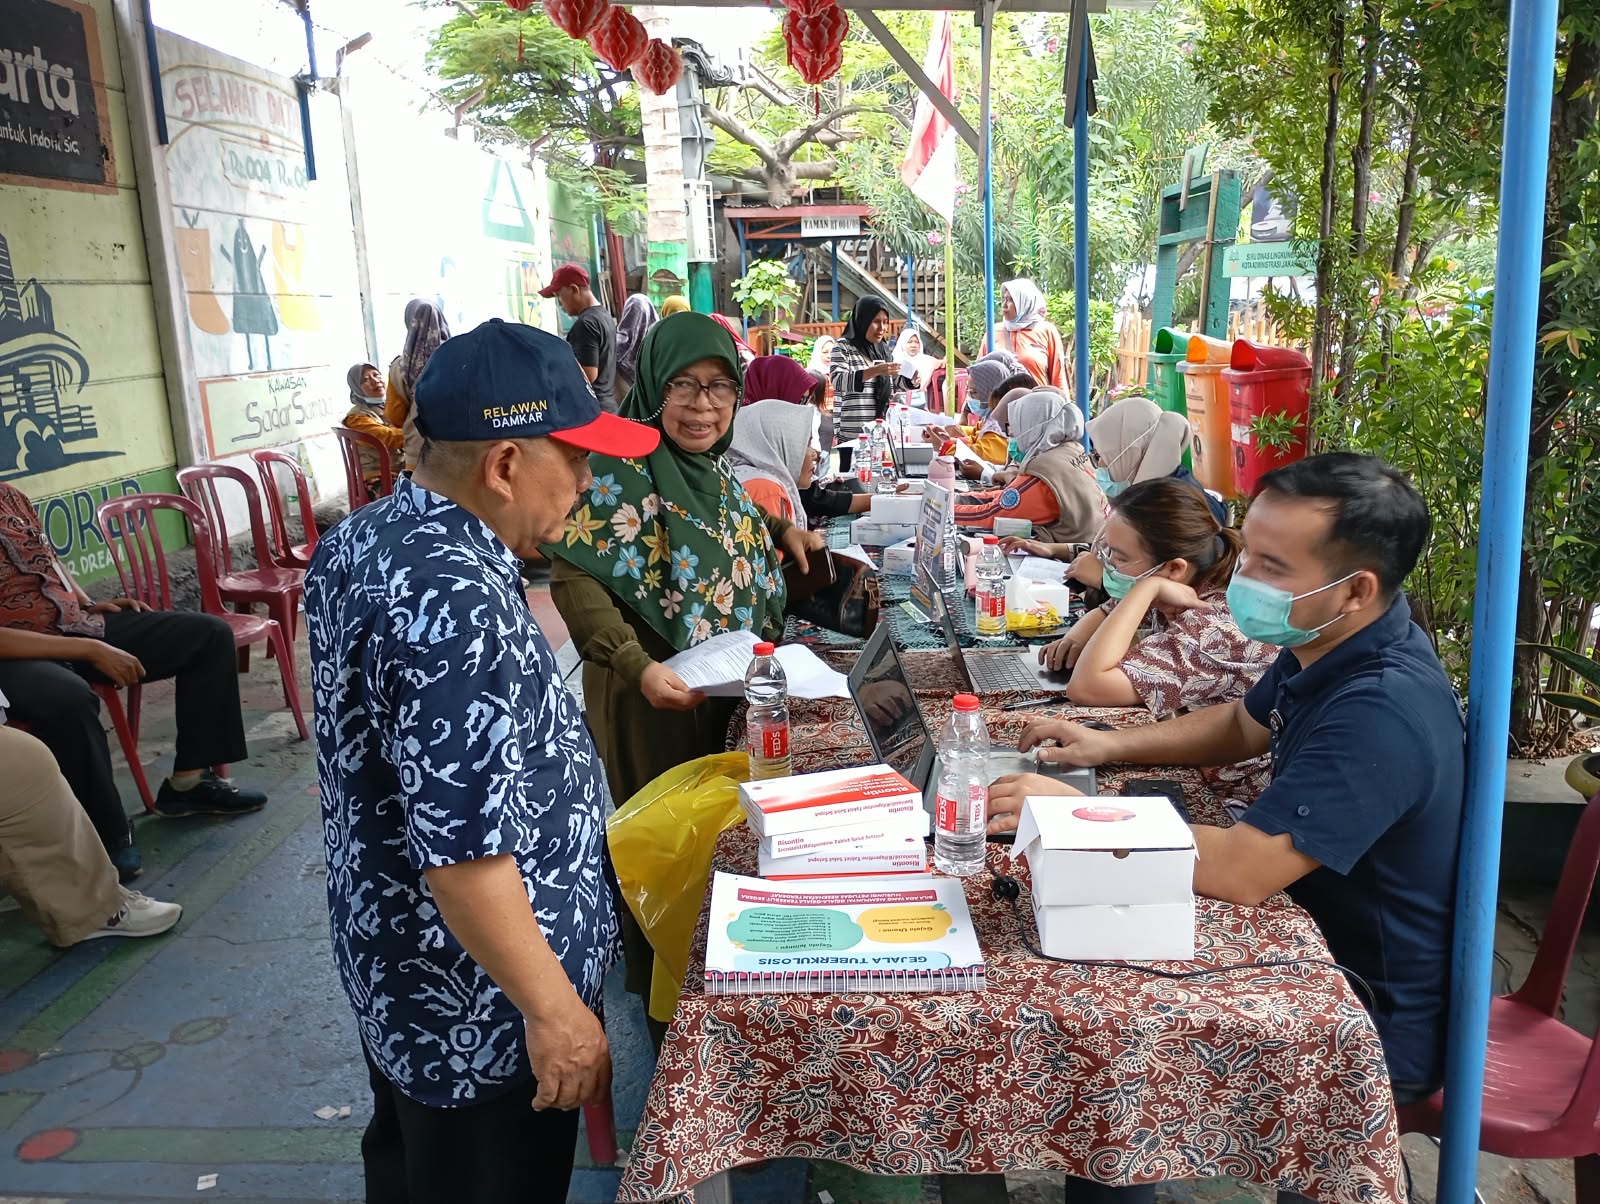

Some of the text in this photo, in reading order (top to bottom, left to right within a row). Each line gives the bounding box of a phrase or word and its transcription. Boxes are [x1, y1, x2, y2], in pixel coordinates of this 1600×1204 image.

[175, 75, 260, 118] SELAMAT
[804, 219, 829, 230] TAMAN
[484, 400, 548, 420] RELAWAN
[492, 412, 543, 429] DAMKAR
[33, 479, 147, 559] ORLD
[863, 786, 909, 796] Risontin
[888, 805, 914, 814] Risontin
[777, 837, 805, 846] Risontin
[758, 956, 928, 966] GEJALA TUBERKULOSIS
